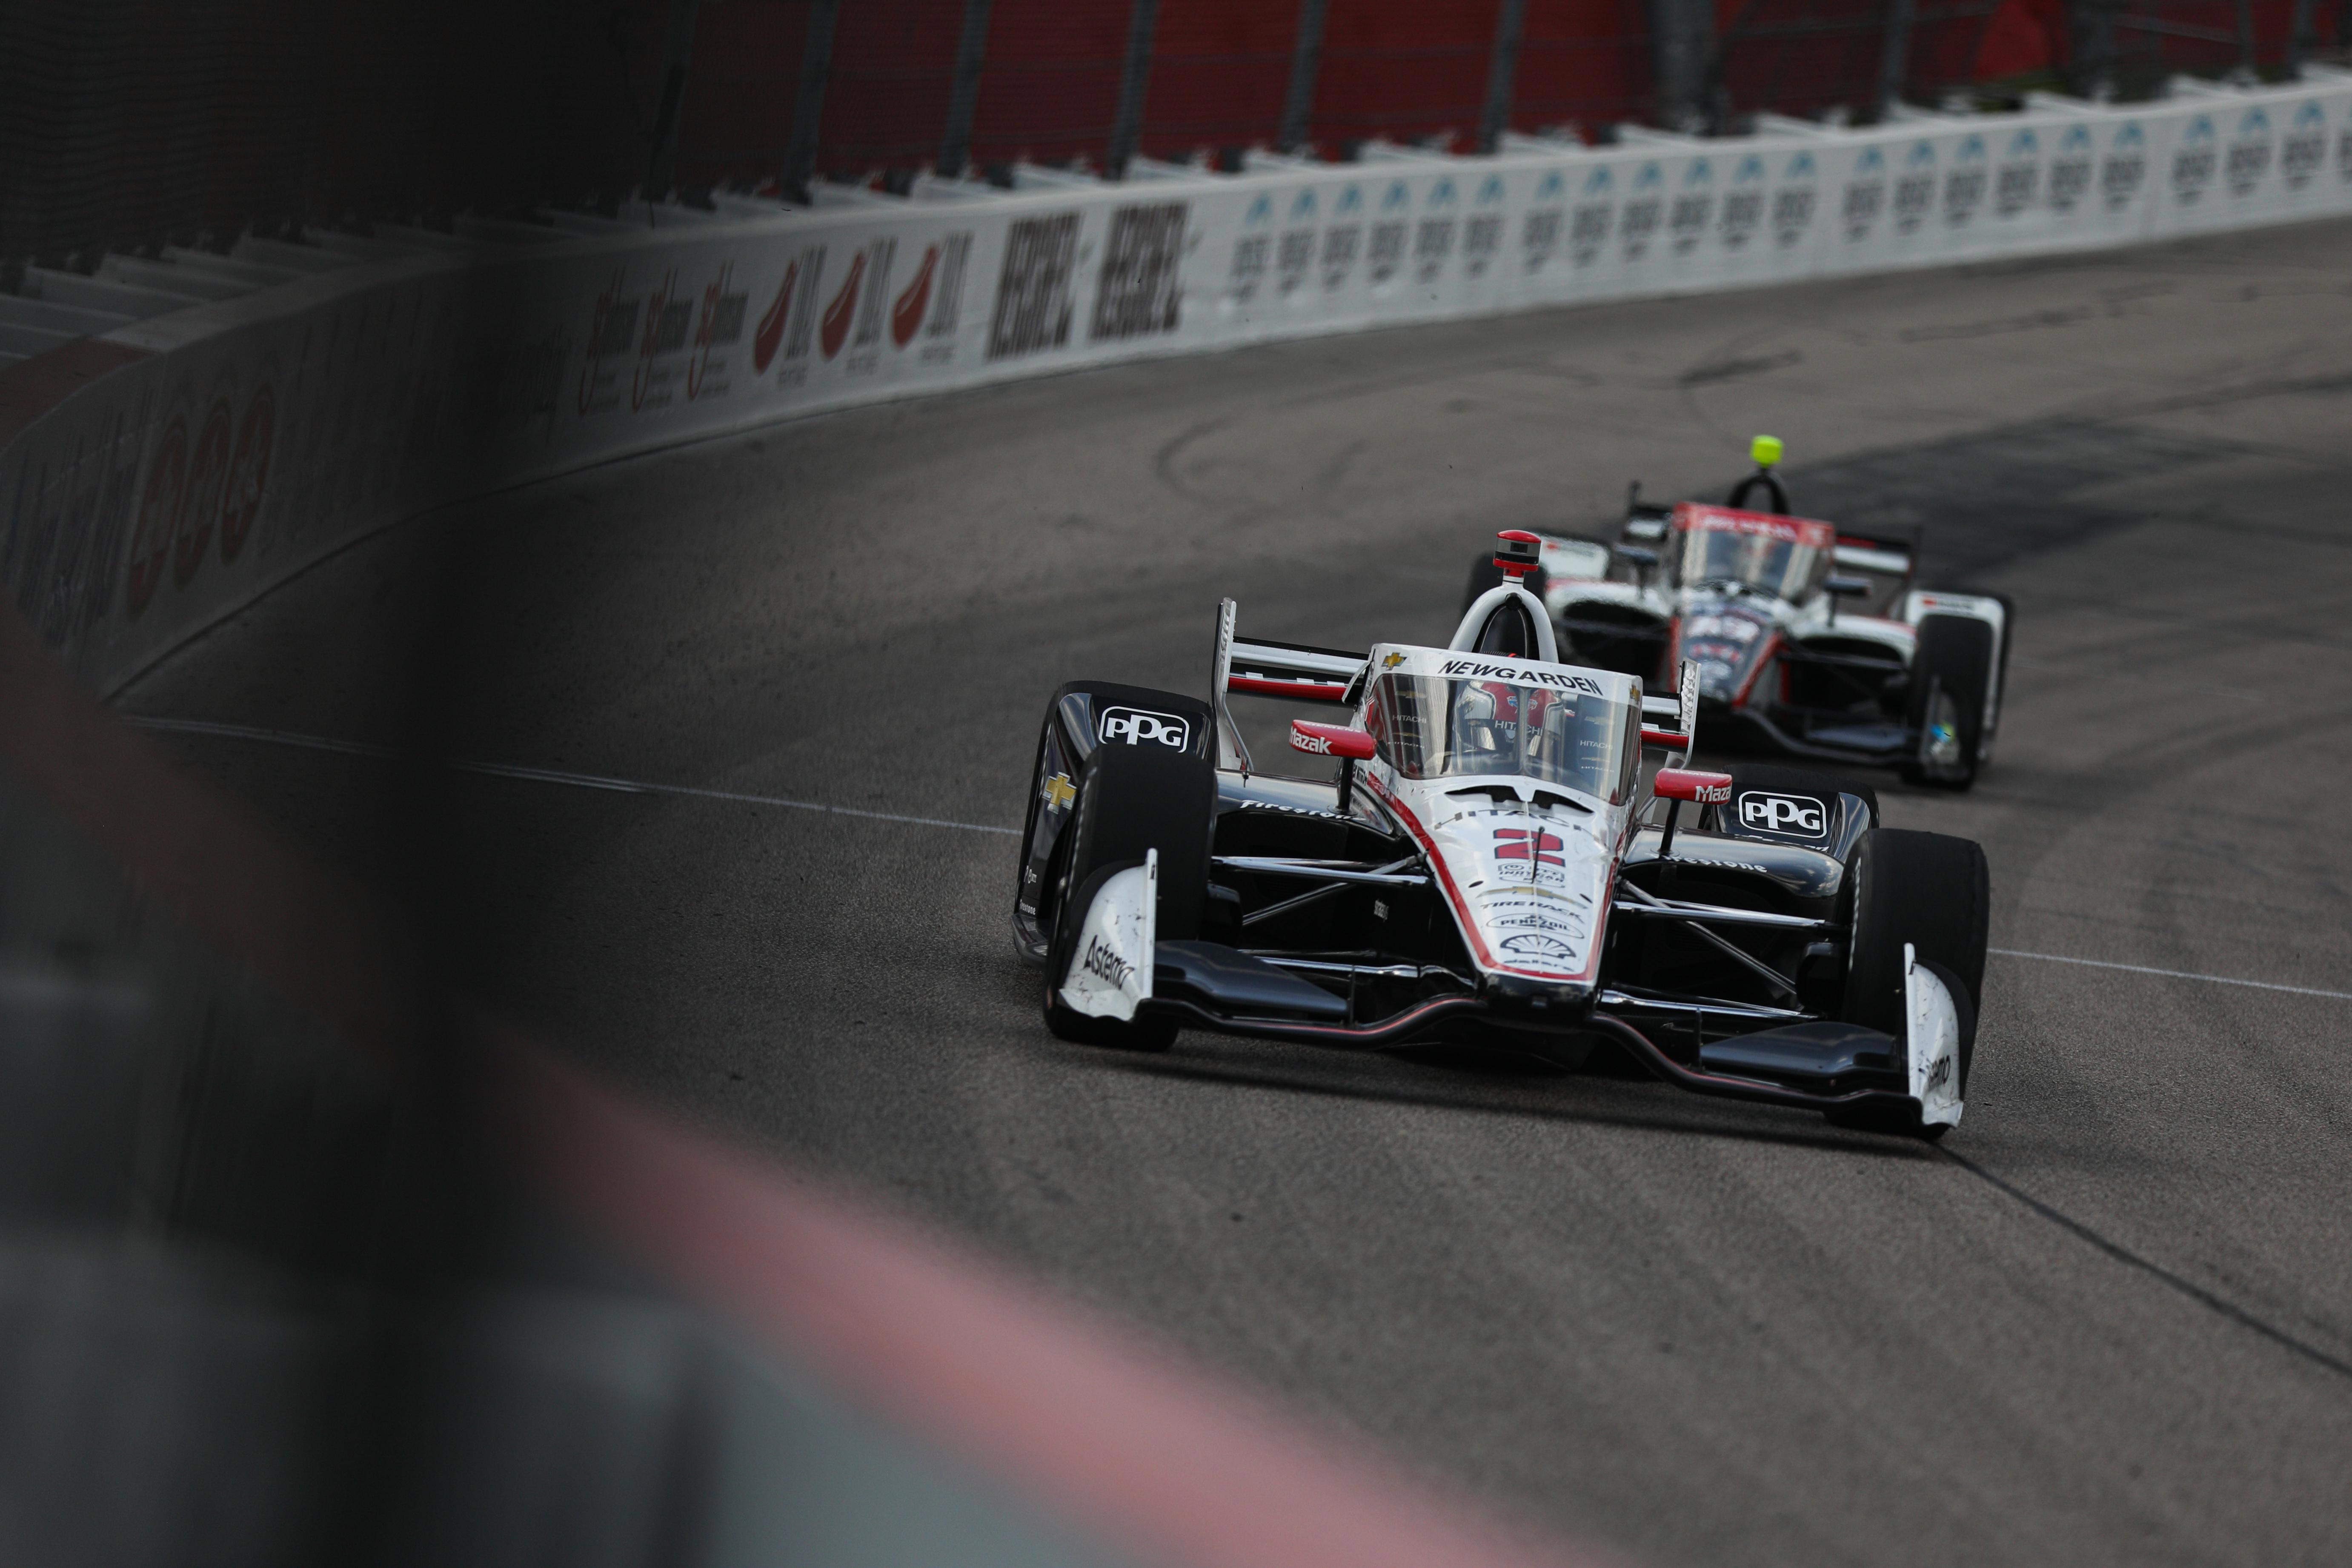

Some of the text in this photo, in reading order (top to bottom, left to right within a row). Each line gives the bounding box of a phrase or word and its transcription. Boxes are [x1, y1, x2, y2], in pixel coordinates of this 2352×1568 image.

[1437, 660, 1604, 695] NEWGARDEN
[1105, 714, 1183, 745] PPG
[1392, 715, 1427, 724] HITACHI
[1494, 720, 1544, 736] HITCHI
[1289, 725, 1333, 755] Mazak
[1579, 740, 1614, 750] HITACHI
[1694, 785, 1732, 802] Maza
[1240, 800, 1367, 821] Firestone
[1745, 798, 1820, 830] PPG
[1493, 828, 1566, 867] 2
[1645, 853, 1767, 873] Firestone
[1480, 901, 1585, 924] TIRE RACK
[1083, 935, 1135, 990] Astemo
